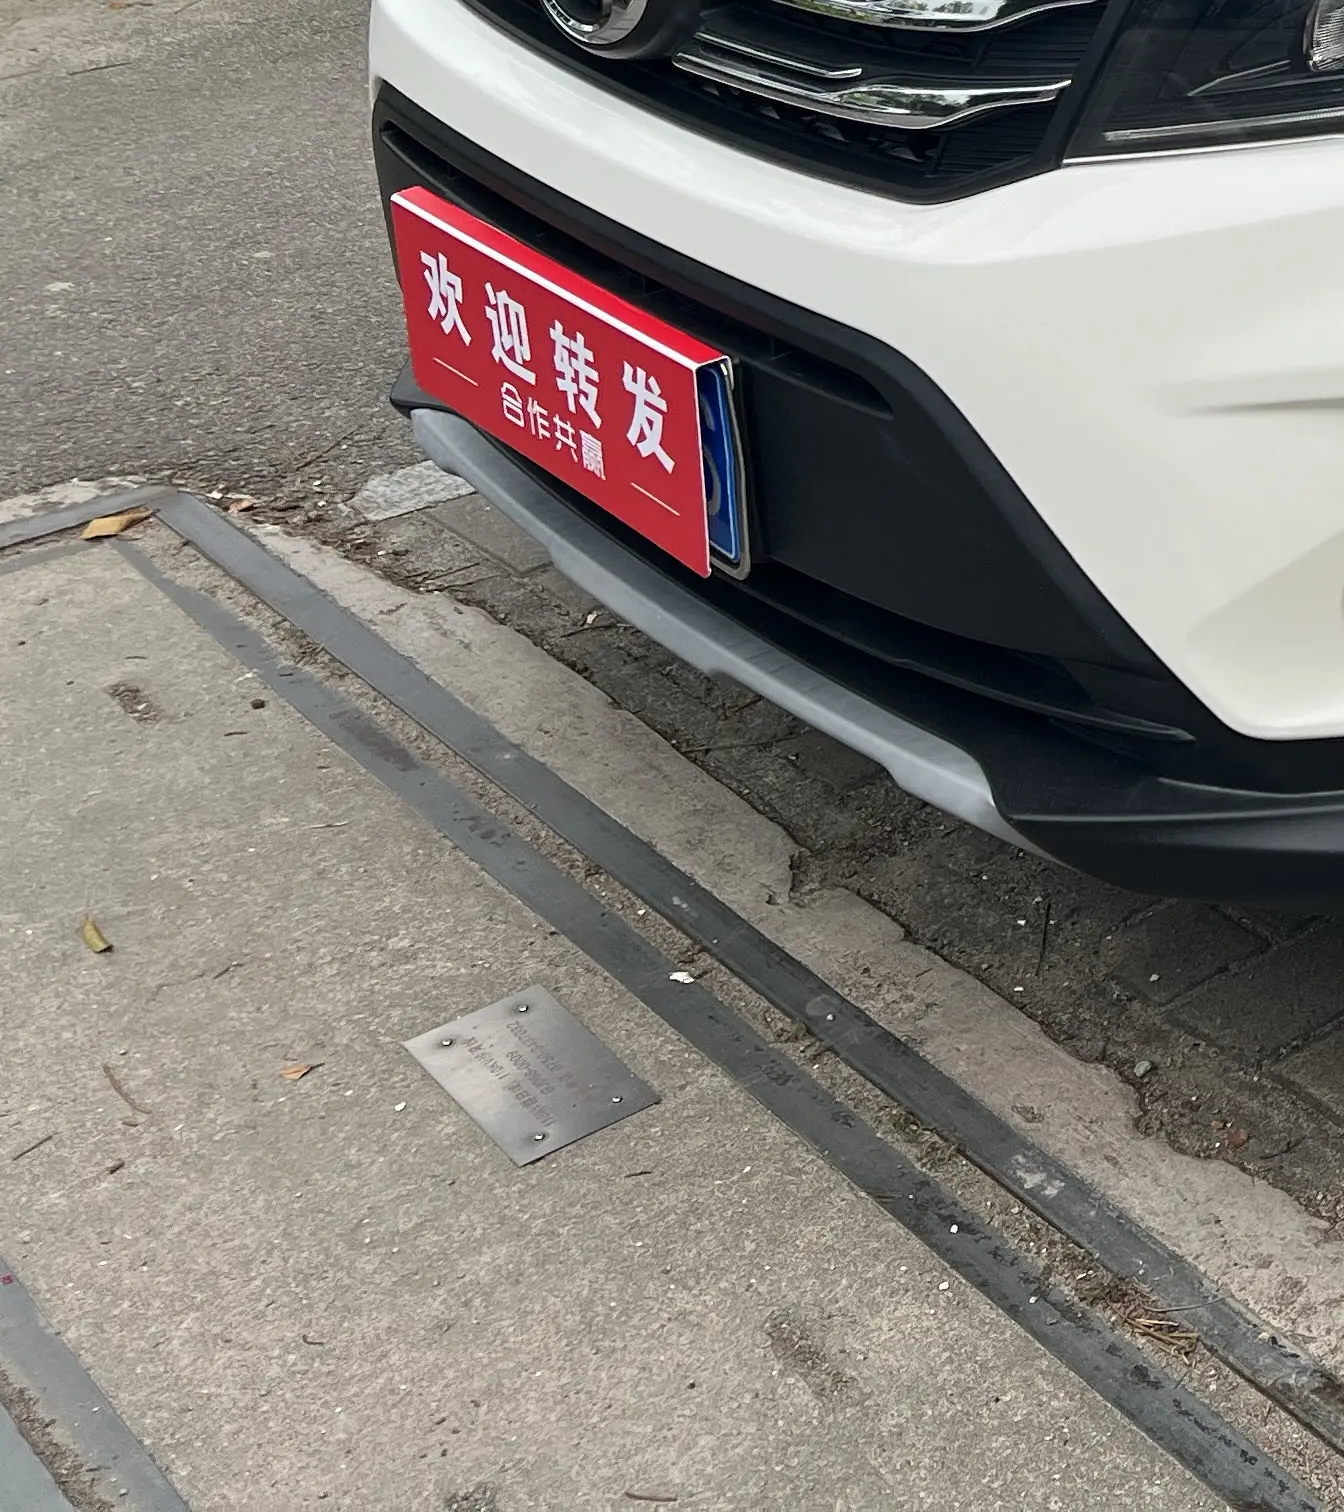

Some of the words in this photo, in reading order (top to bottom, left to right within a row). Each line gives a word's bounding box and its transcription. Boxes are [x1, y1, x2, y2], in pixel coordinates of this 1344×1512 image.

[420, 250, 675, 475] 欢迎转发
[501, 381, 606, 481] 合作共赢
